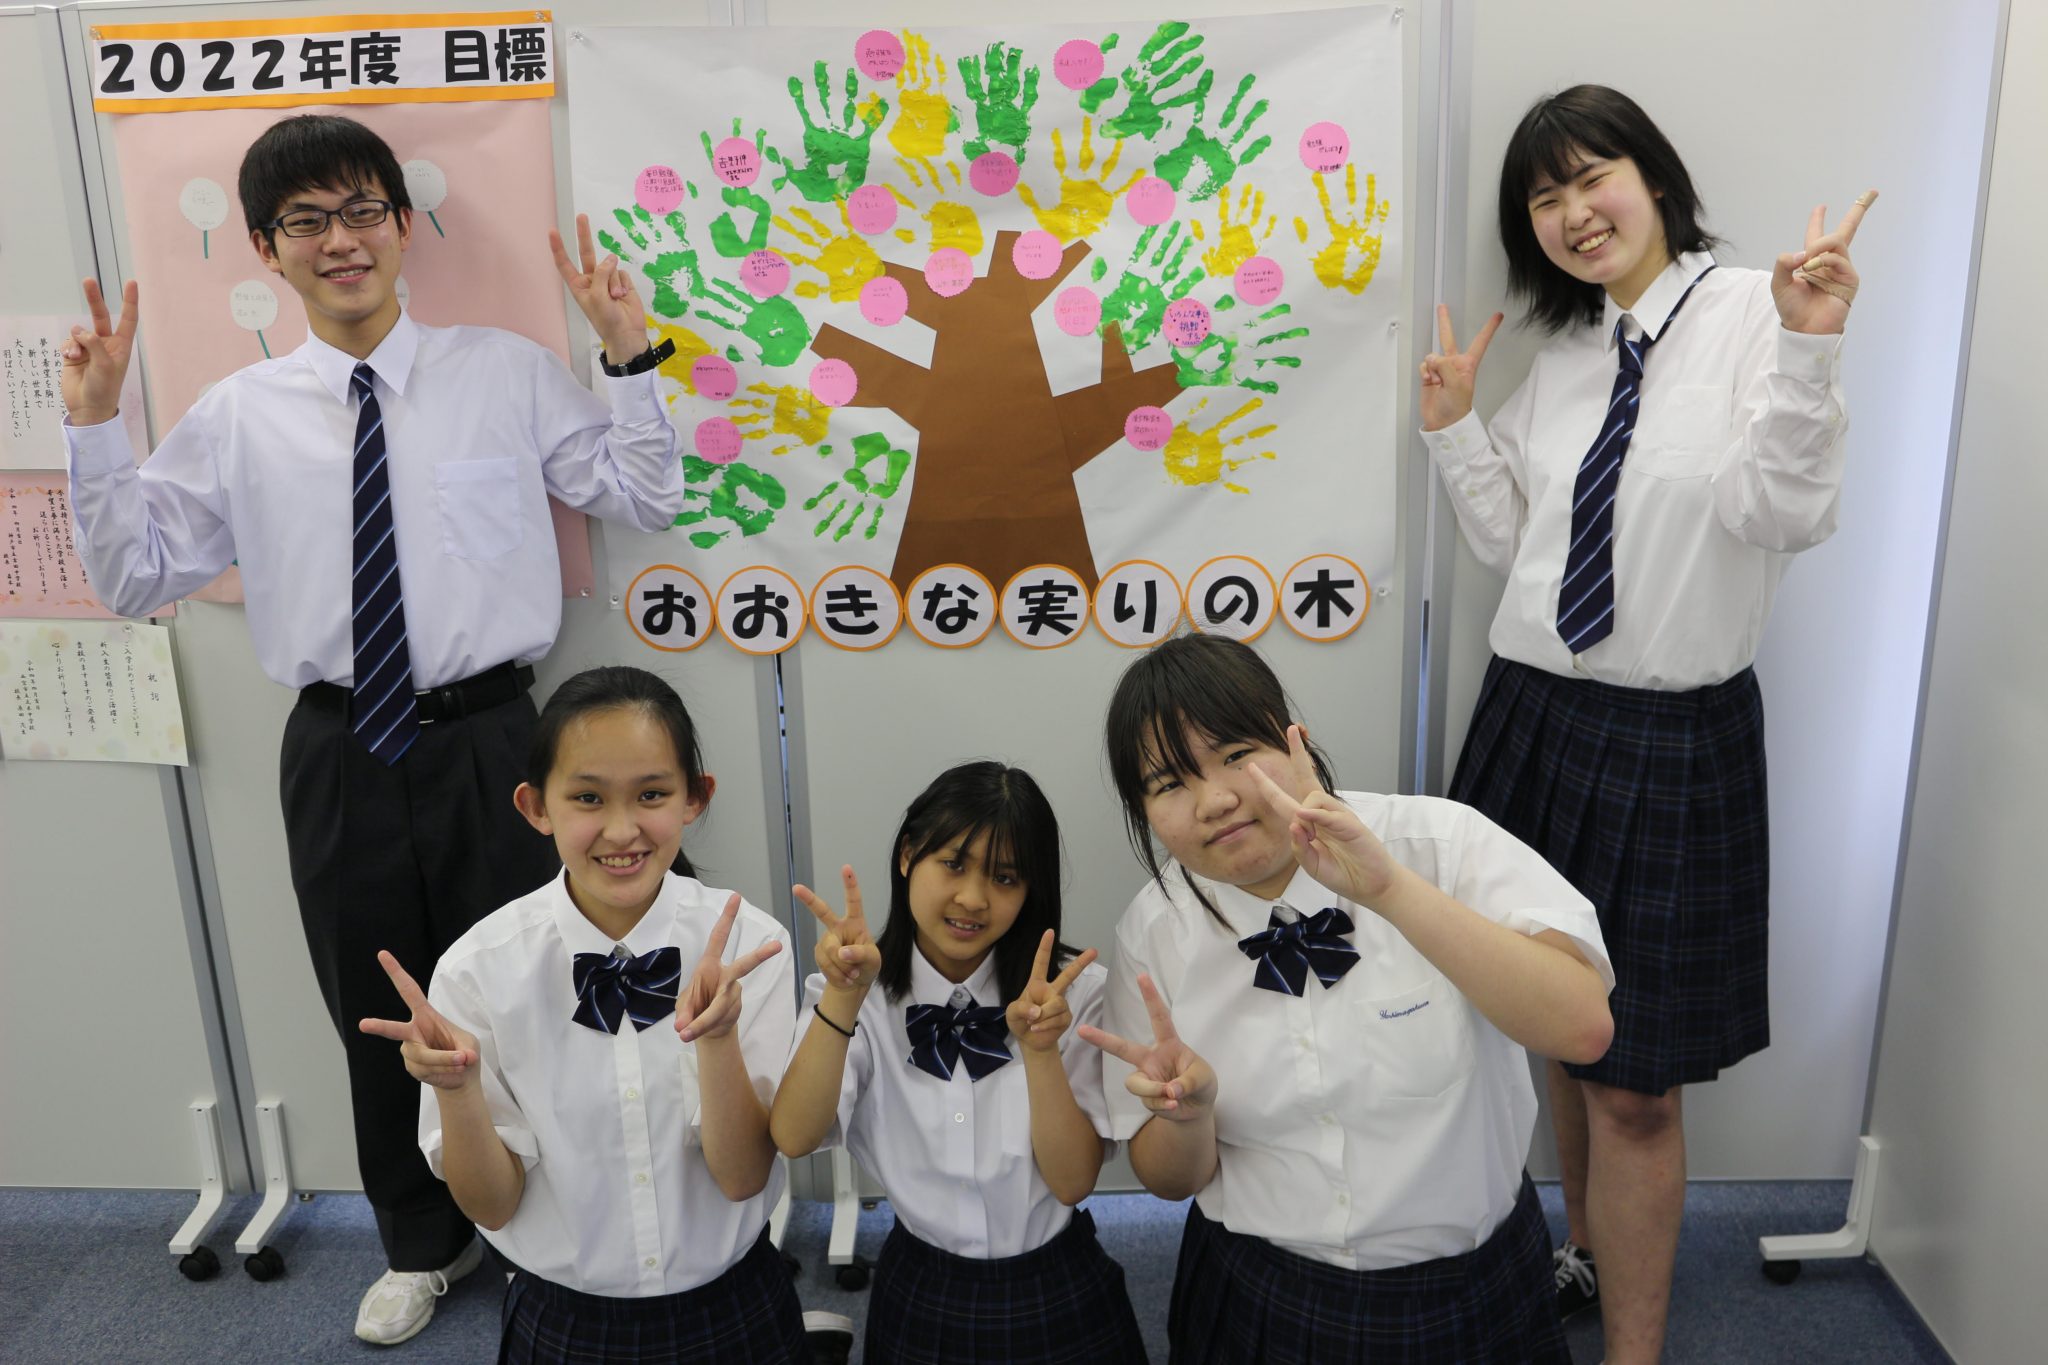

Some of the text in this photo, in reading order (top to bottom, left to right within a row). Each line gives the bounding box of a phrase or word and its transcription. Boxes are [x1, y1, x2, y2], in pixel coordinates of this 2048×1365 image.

[100, 27, 547, 93] 2022年度 目標
[28, 348, 43, 409] 新しい世界で
[40, 338, 55, 408] 夢や希望を胸に
[642, 568, 1356, 640] おおきな実りの木
